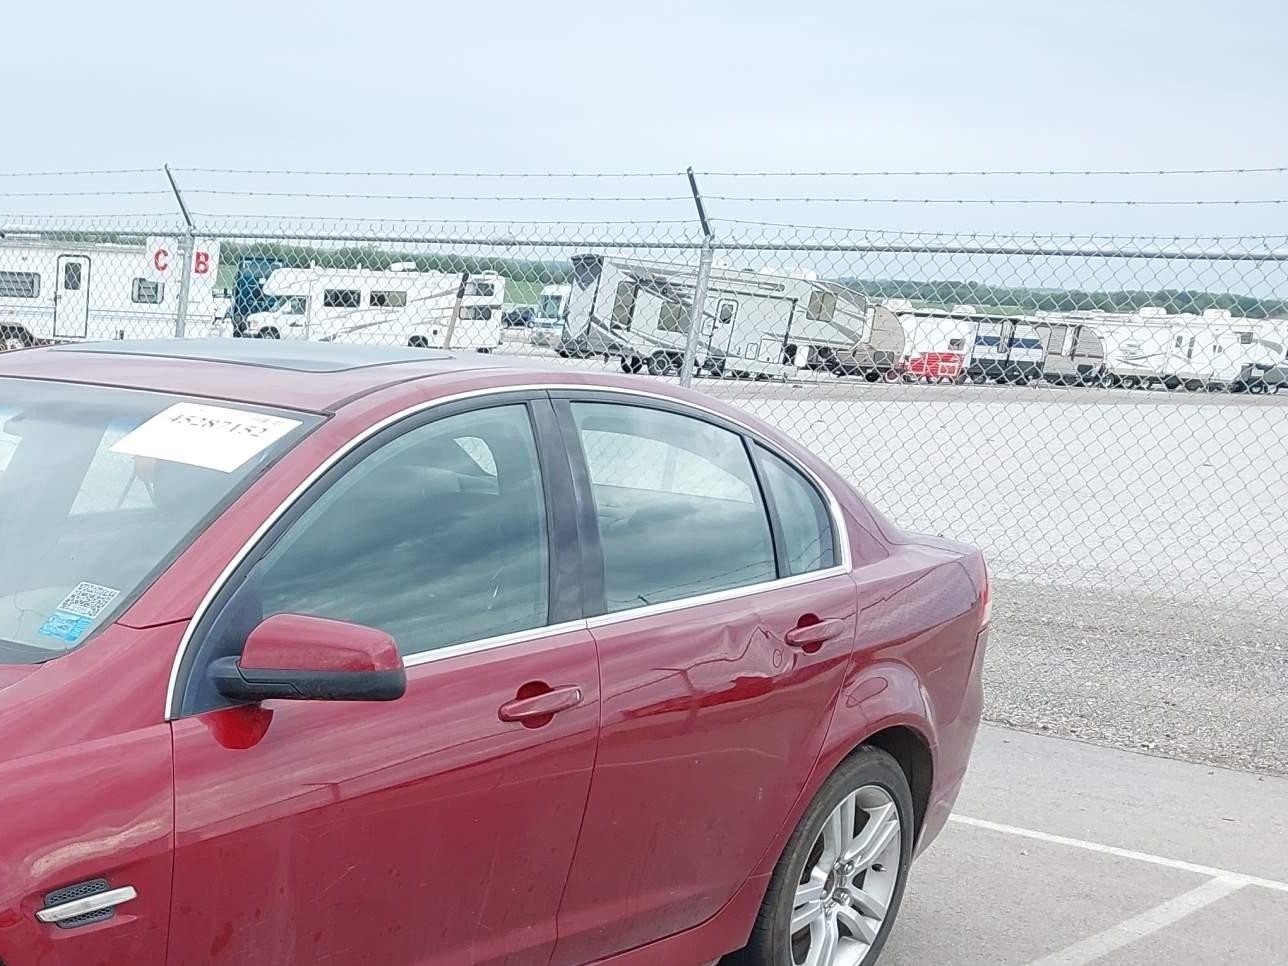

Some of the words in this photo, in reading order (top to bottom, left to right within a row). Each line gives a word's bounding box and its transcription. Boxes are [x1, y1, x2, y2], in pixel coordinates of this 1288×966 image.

[154, 249, 169, 271] C
[194, 252, 210, 274] B
[168, 414, 268, 438] 45287152
